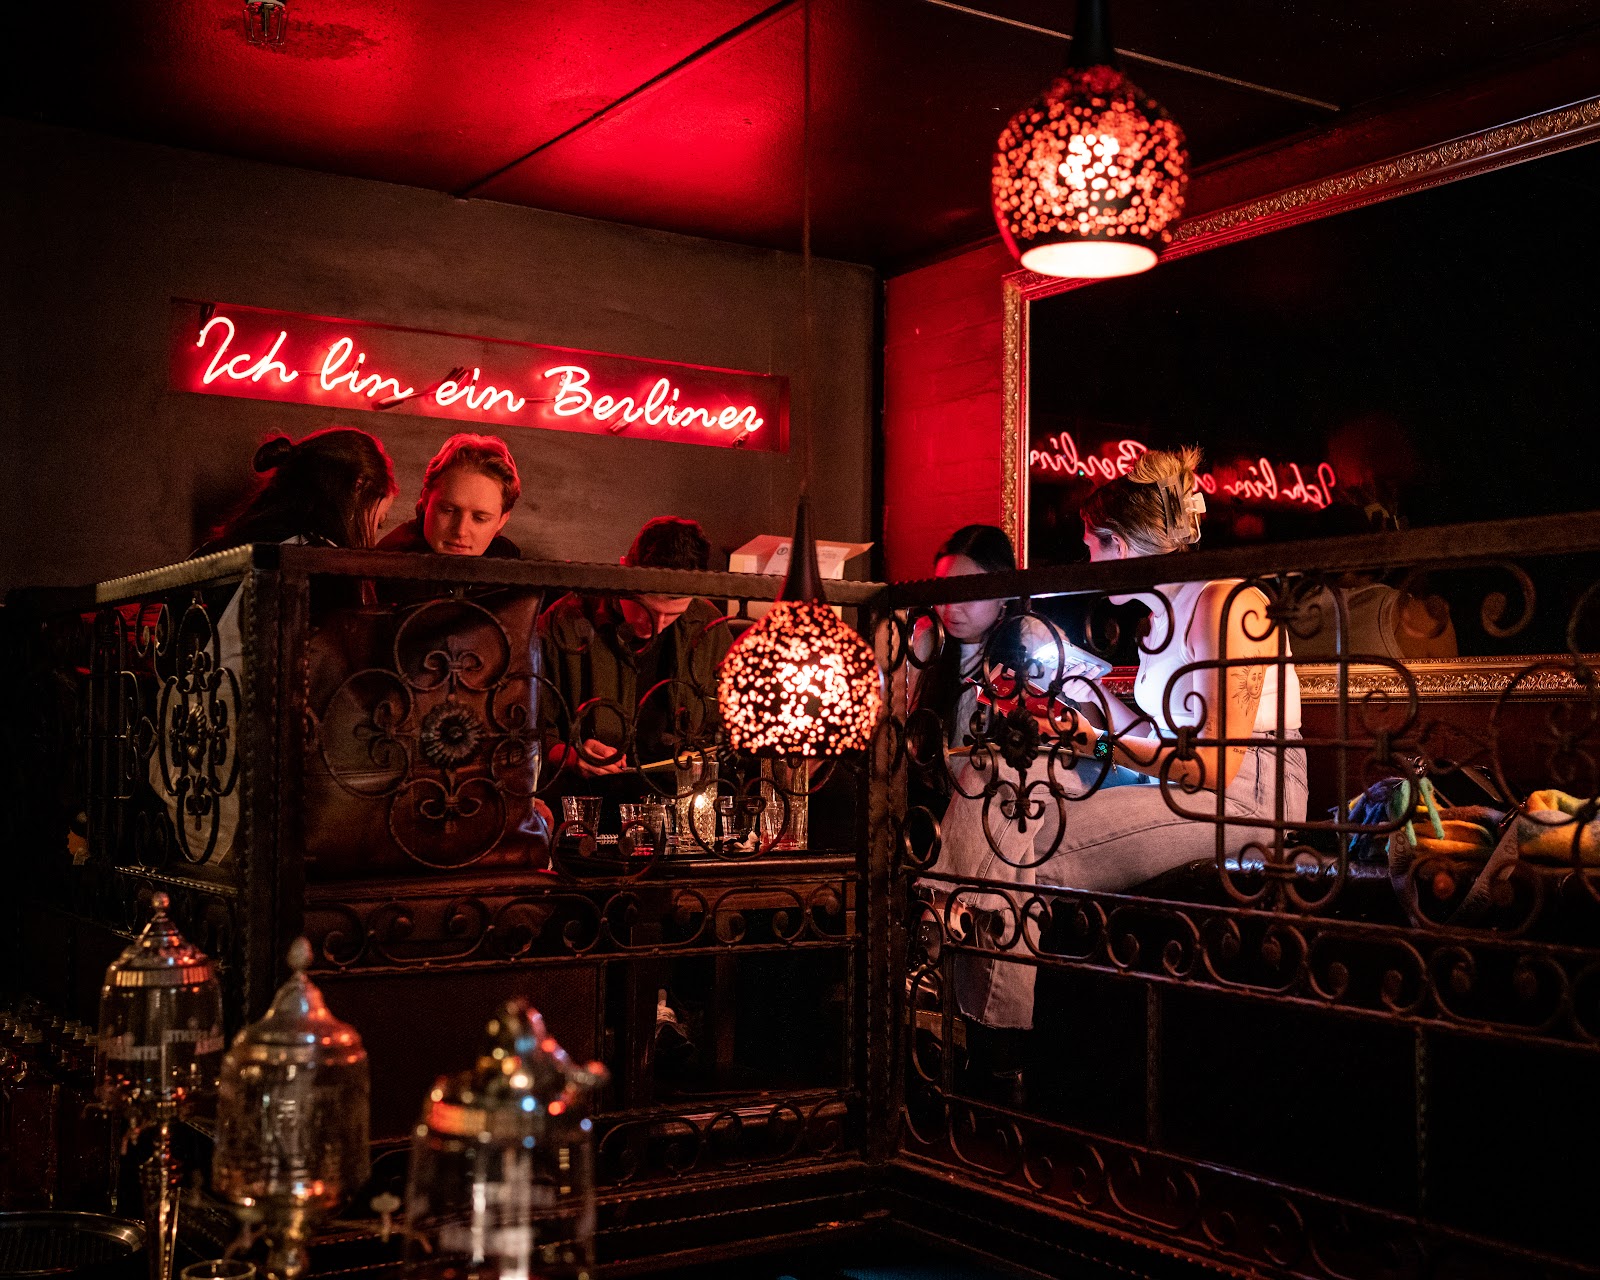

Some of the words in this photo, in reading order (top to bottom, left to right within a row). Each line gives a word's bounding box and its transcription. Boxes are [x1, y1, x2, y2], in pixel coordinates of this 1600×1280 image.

[196, 316, 299, 385] Ich
[320, 337, 414, 399] bin
[435, 367, 526, 413] ein
[544, 365, 764, 433] Berliner
